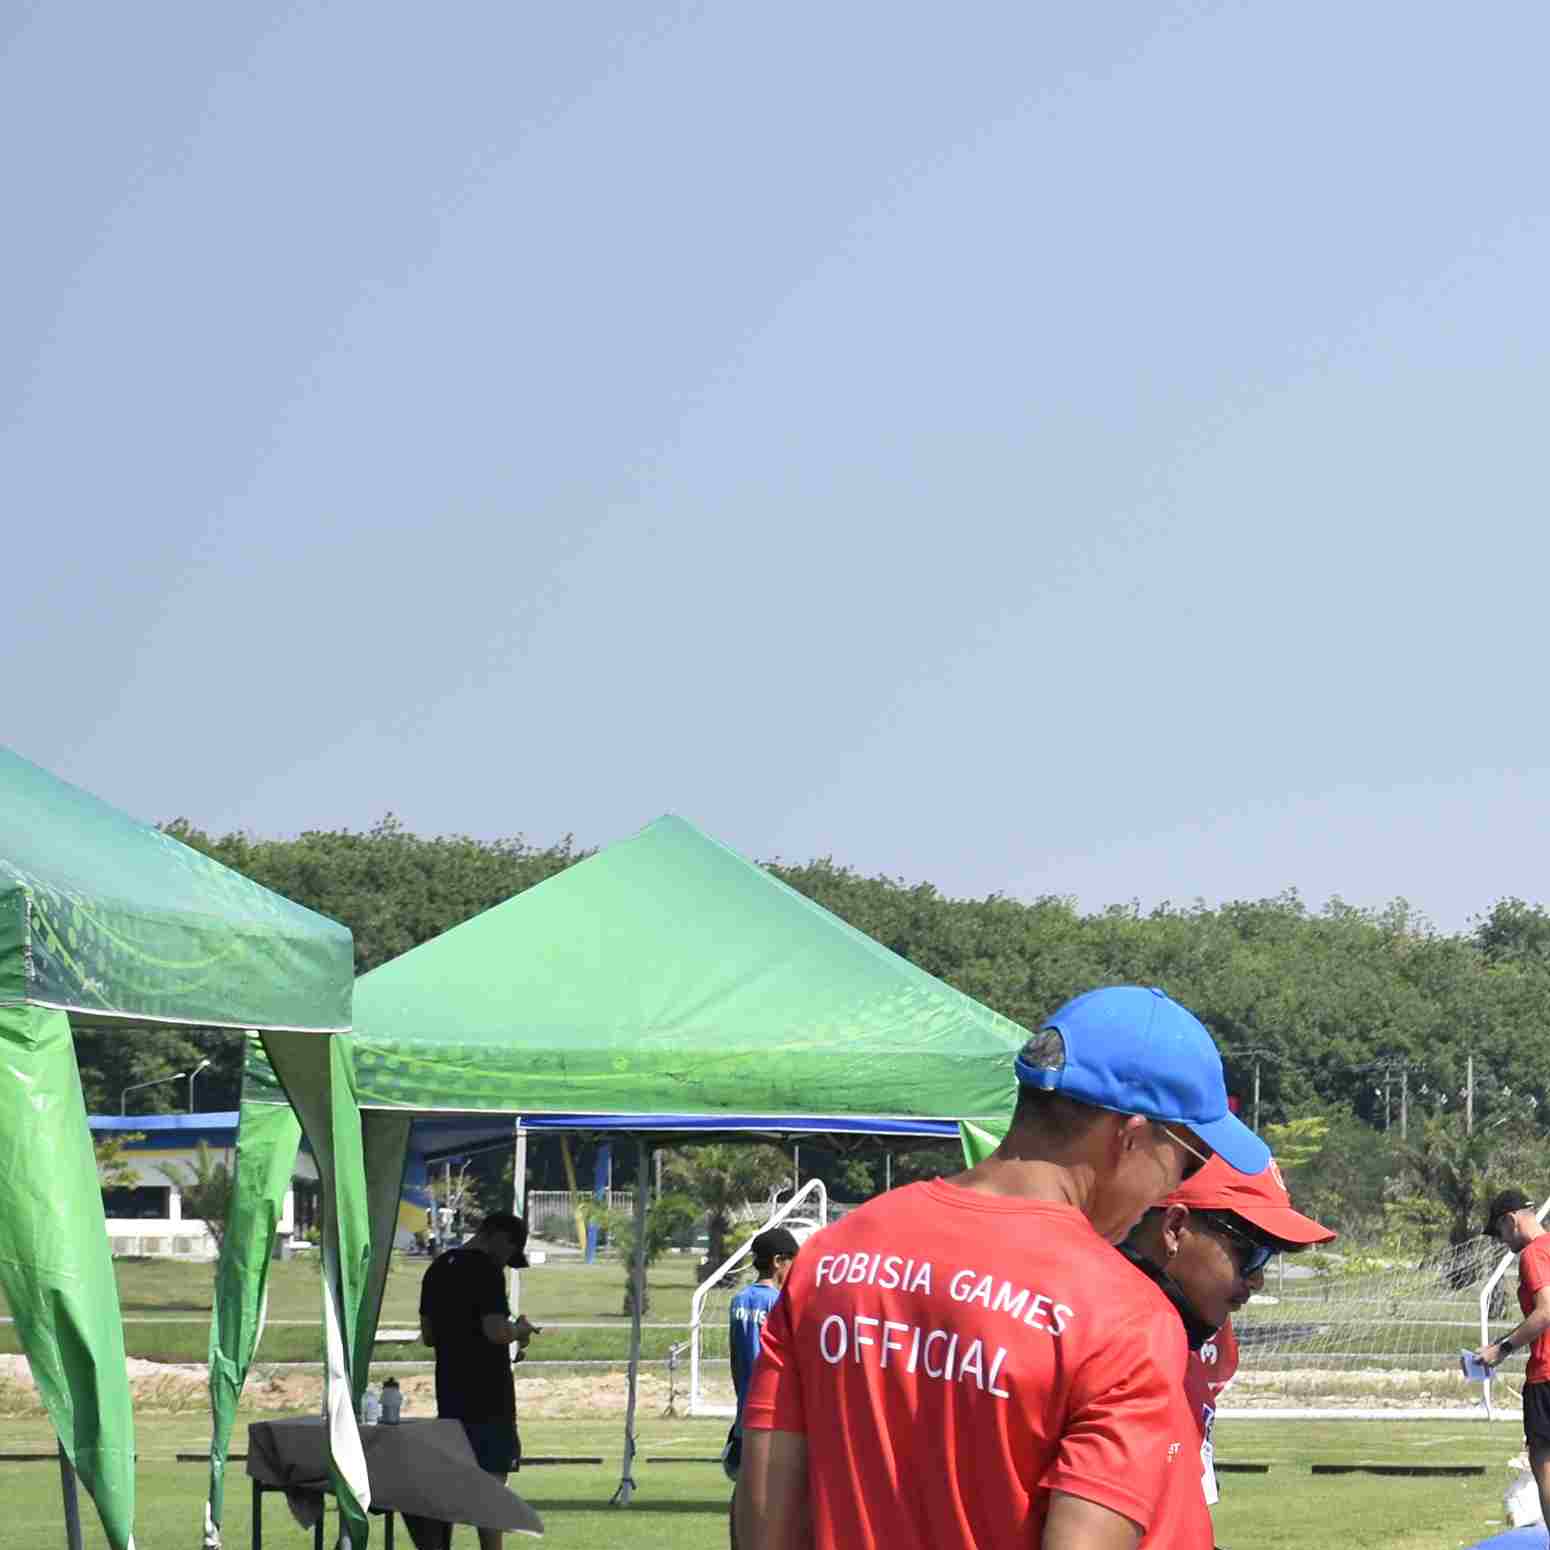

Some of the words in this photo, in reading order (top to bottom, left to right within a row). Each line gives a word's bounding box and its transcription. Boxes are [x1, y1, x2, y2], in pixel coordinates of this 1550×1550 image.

[815, 1252, 933, 1296] FOBISIA
[949, 1269, 1075, 1337] GAMES
[819, 1314, 1010, 1399] OFFICIAL
